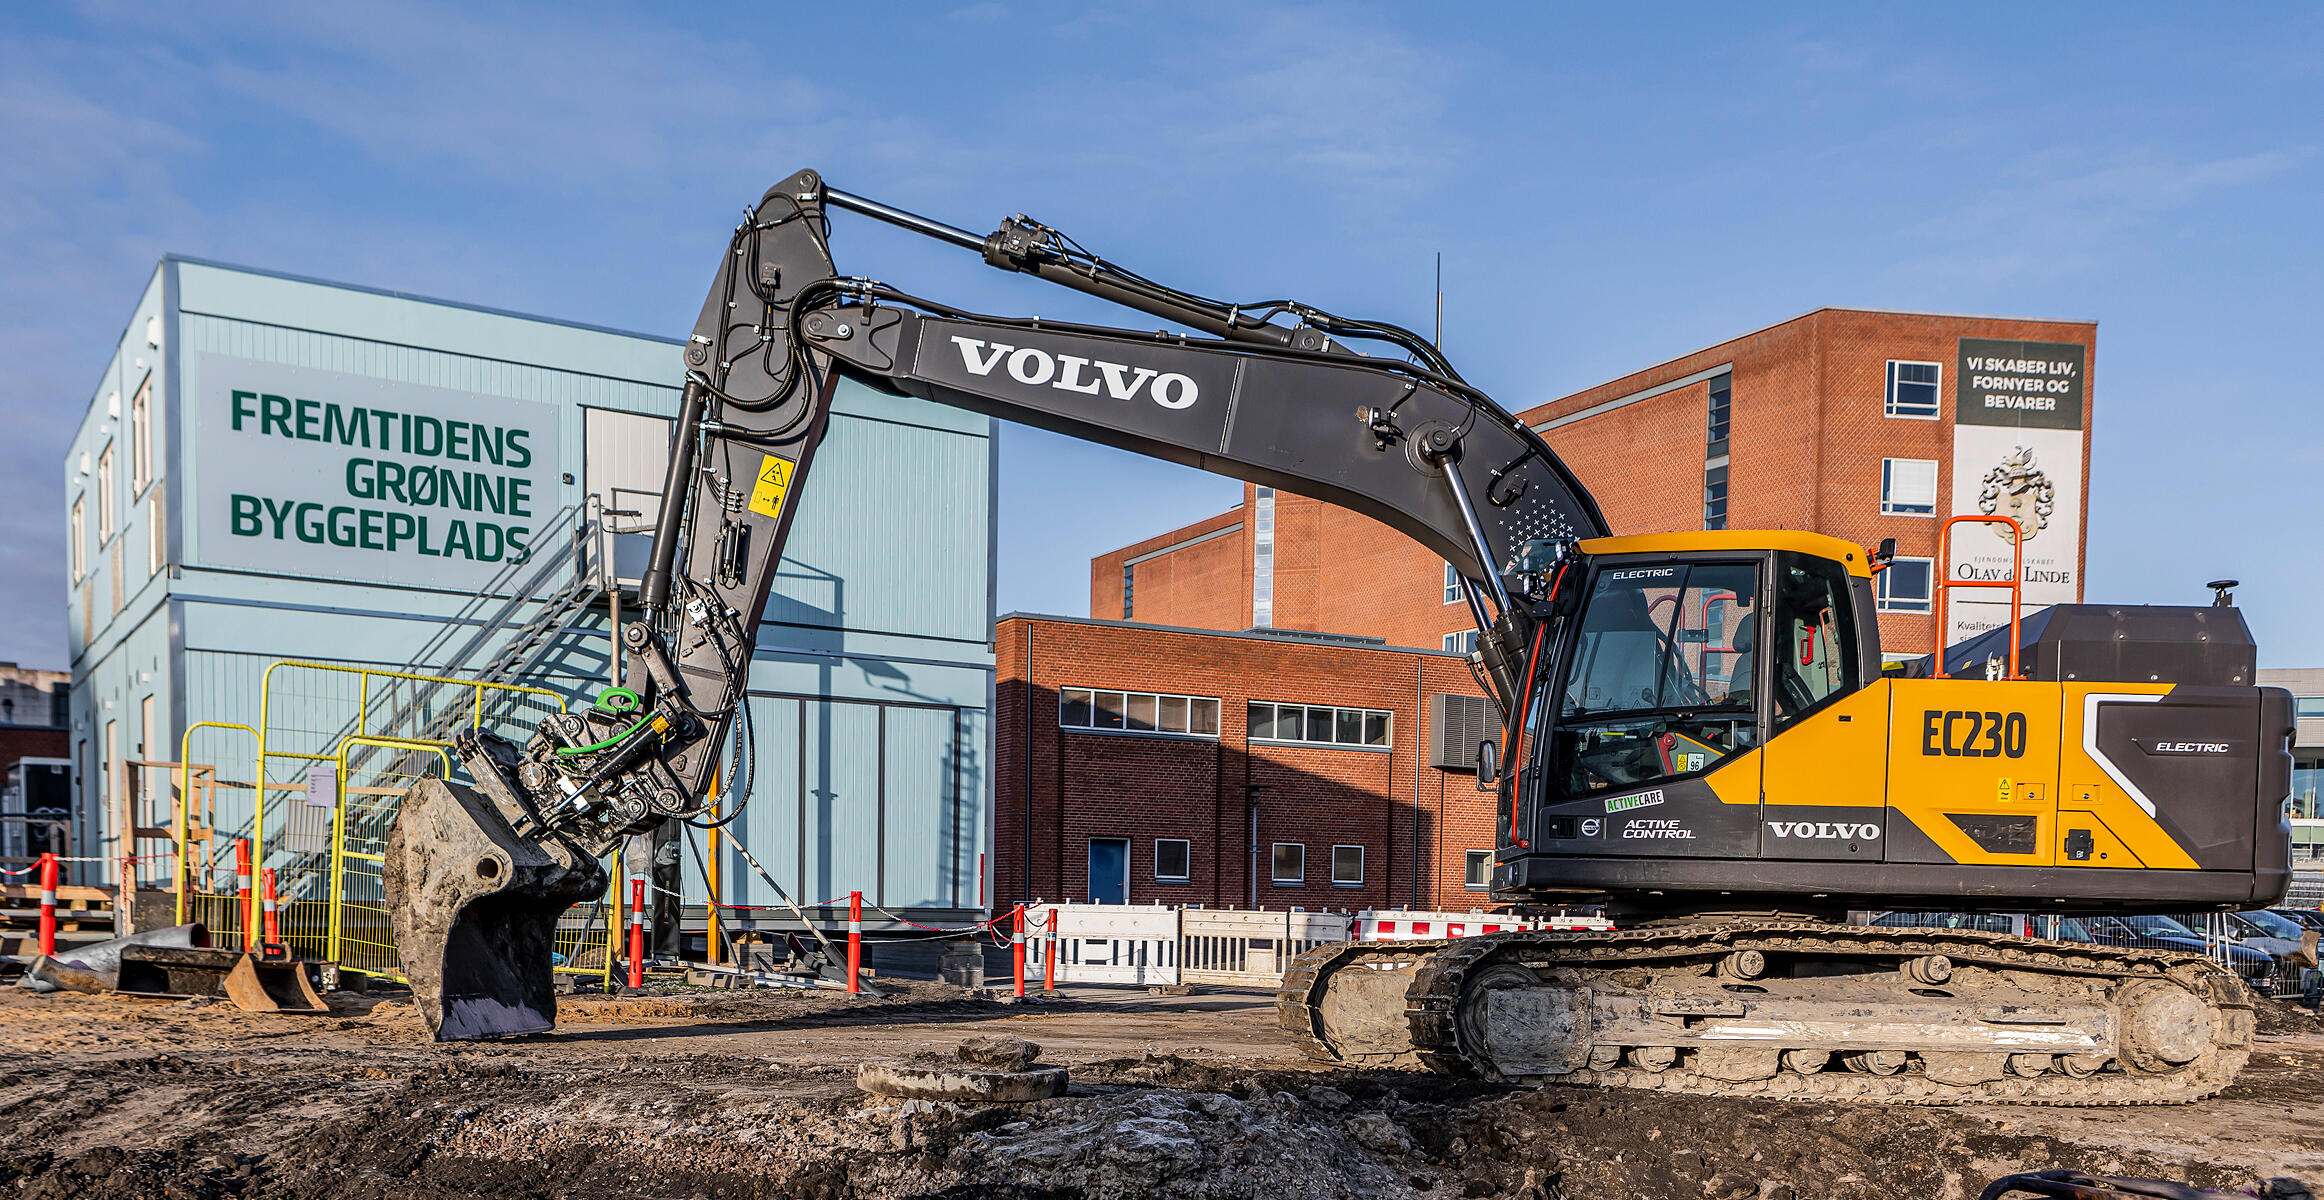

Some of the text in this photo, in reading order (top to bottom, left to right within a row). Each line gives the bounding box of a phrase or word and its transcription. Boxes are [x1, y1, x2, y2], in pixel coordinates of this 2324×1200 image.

[951, 335, 1199, 410] VOLVO
[1967, 357, 2077, 378] VI SKABER LIV,
[1972, 375, 2070, 393] FORNYER OG
[1984, 394, 2056, 410] BEVARER
[231, 389, 532, 469] FREMTIDENS
[346, 457, 532, 518] GRØNNE
[231, 494, 532, 565] BYGGEPLADS
[1613, 568, 1674, 580] ELECTRIC
[1958, 563, 2070, 584] OLAV d LINDE
[1922, 710, 2026, 758] EC230
[2156, 742, 2229, 753] ELECTRIC
[1690, 761, 1700, 770] 96
[1607, 791, 1662, 812] ACTIVECARE
[1624, 820, 1680, 829] ACTIVE
[1767, 822, 1880, 840] VOLVO
[1623, 830, 1697, 839] CONTROL
